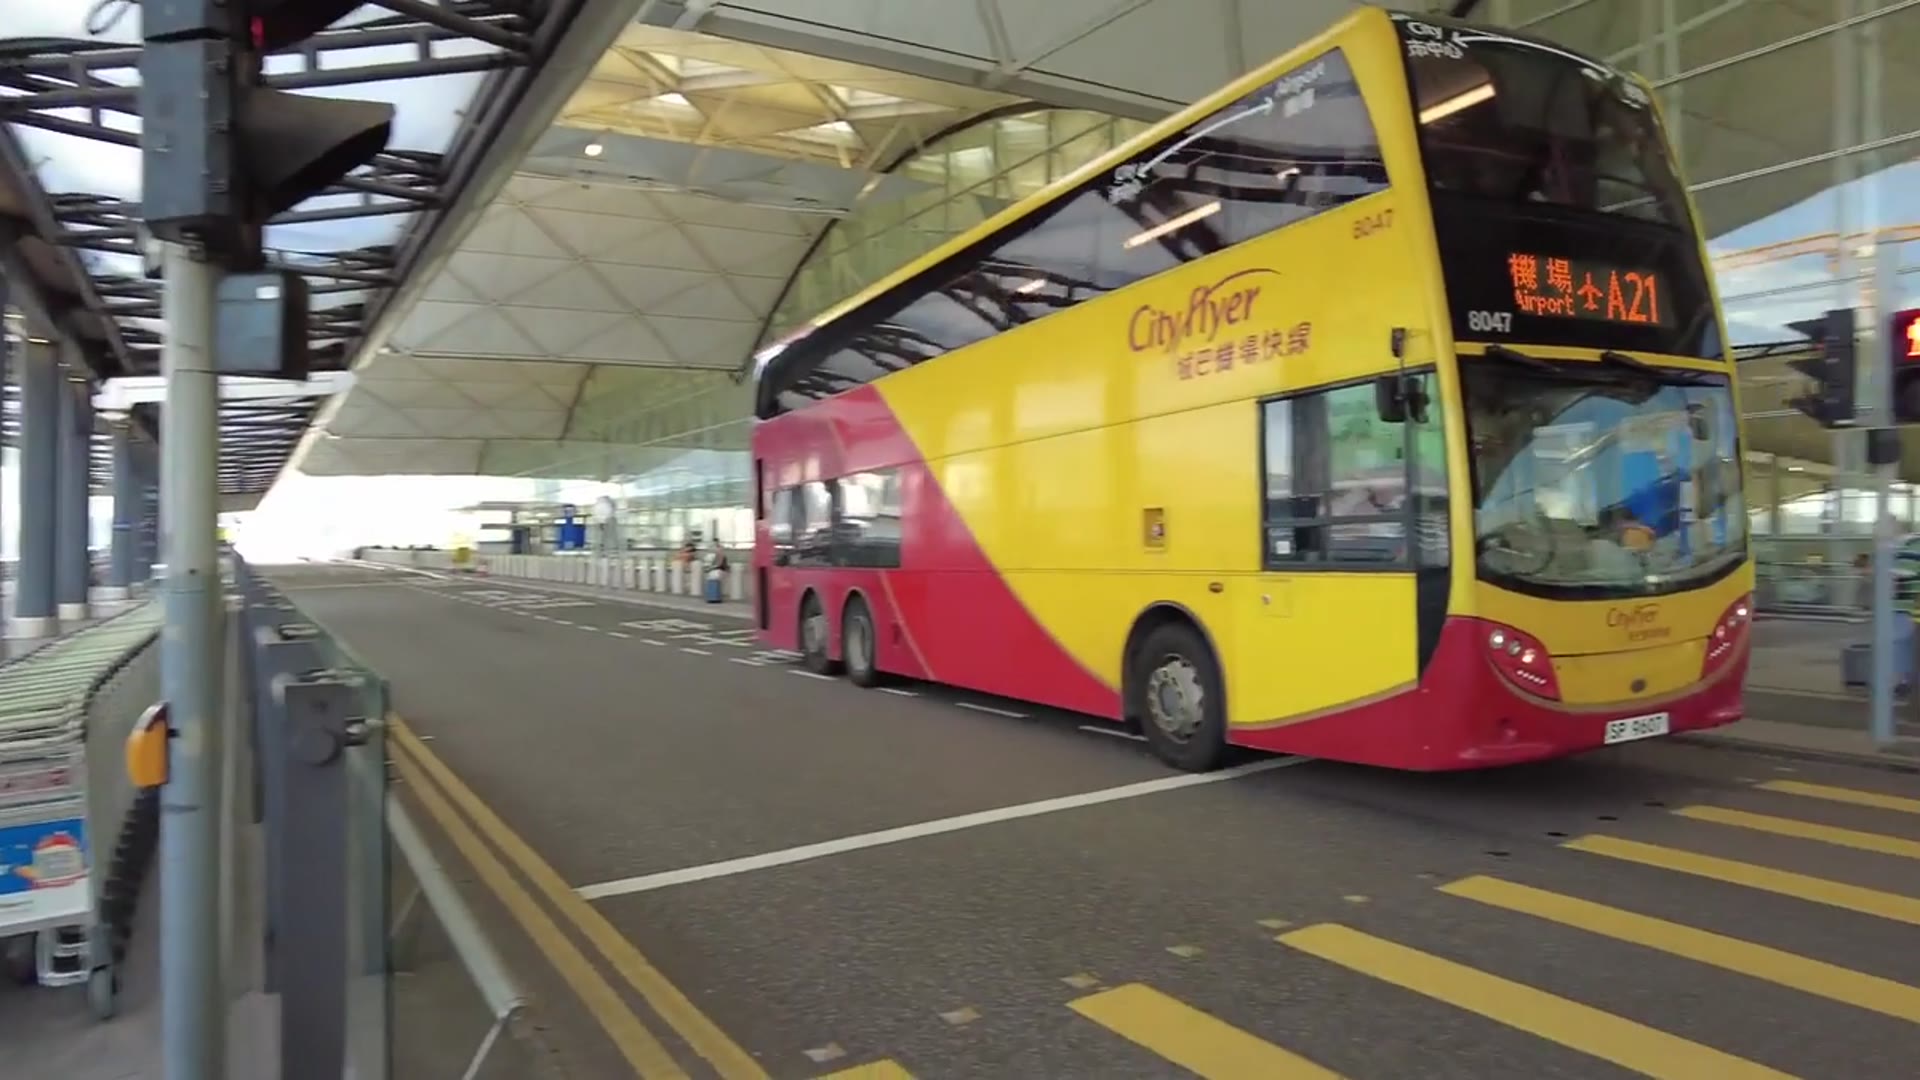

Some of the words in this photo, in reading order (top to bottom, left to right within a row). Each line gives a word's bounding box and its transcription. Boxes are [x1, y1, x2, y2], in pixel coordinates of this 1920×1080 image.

[1354, 209, 1392, 240] 8047
[1508, 253, 1573, 293] 機場
[1514, 290, 1575, 316] Airport
[1607, 270, 1659, 323] A21
[1468, 310, 1512, 332] 8047
[1610, 722, 1625, 739] SP
